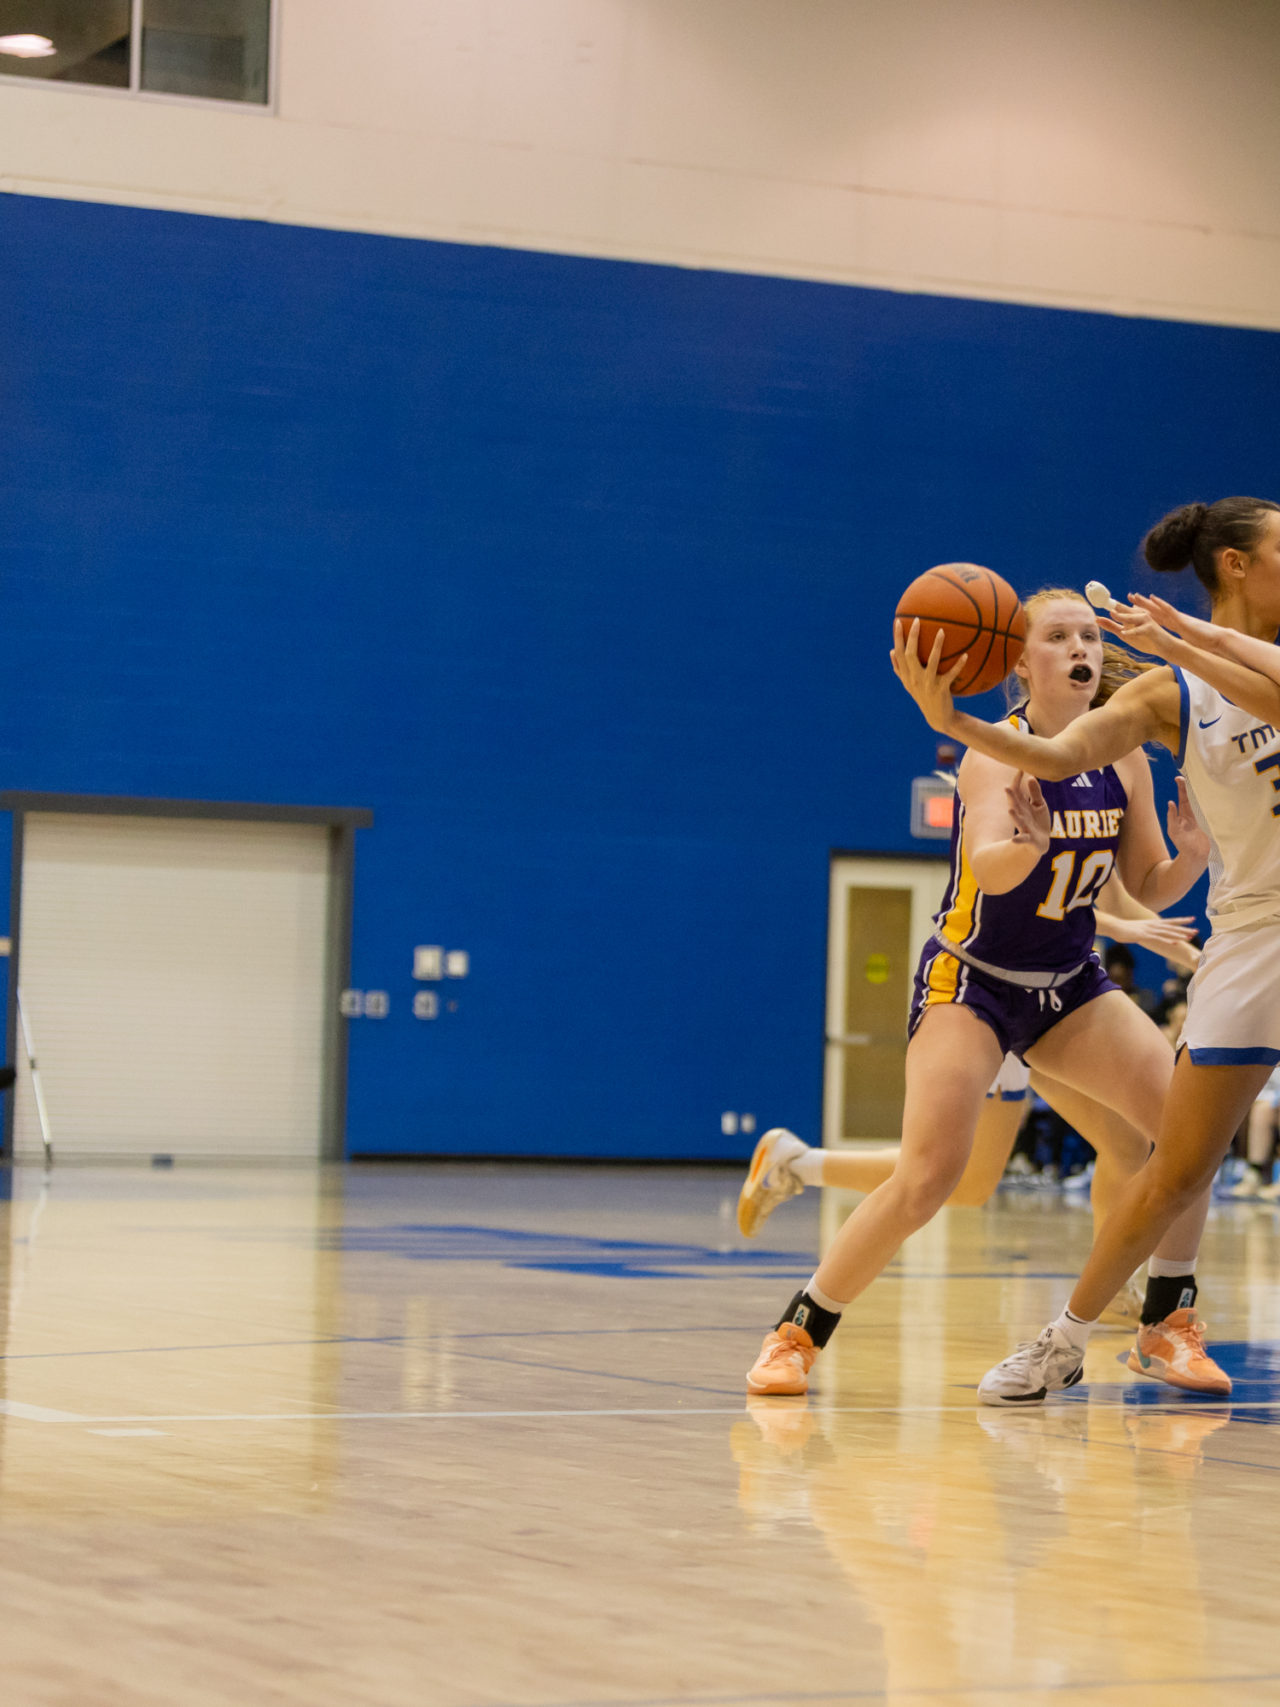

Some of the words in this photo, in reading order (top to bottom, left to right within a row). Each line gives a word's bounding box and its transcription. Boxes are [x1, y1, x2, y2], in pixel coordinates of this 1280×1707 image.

[1231, 724, 1276, 753] TM
[1049, 808, 1124, 839] AURIE
[1036, 849, 1114, 921] 10
